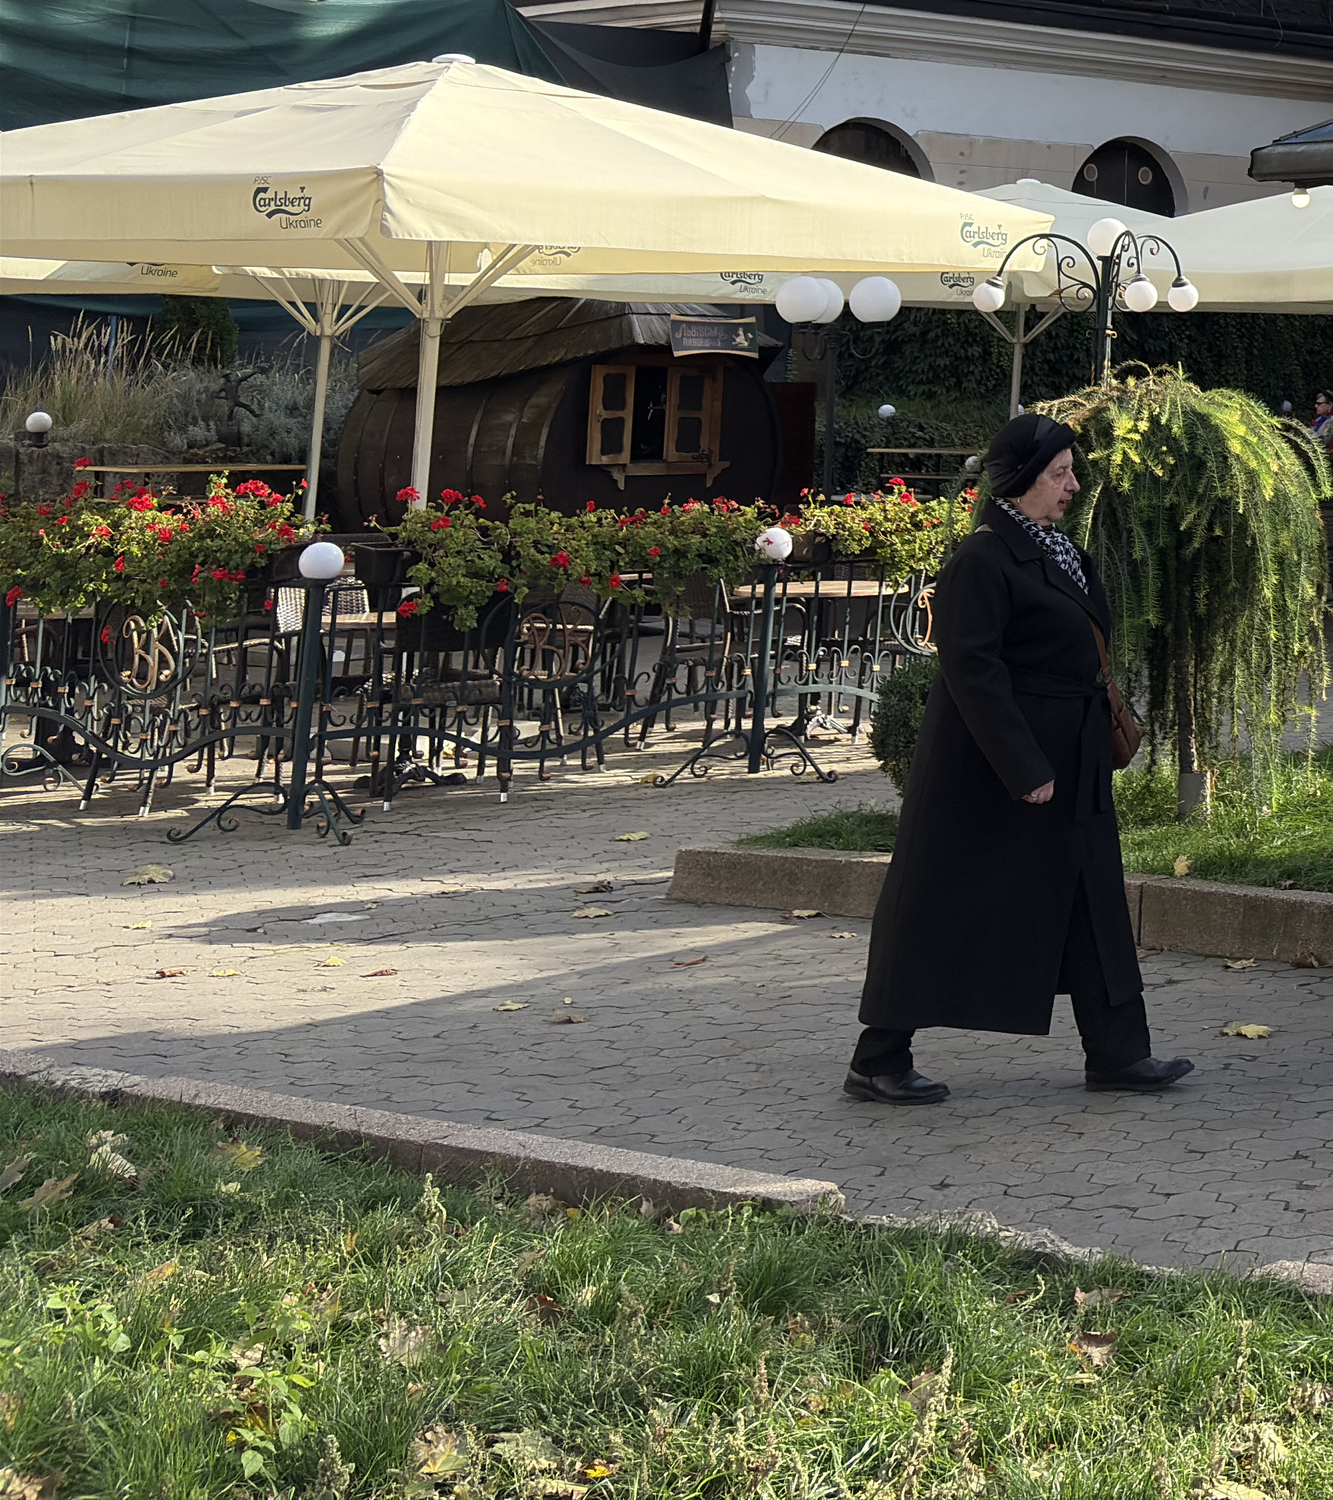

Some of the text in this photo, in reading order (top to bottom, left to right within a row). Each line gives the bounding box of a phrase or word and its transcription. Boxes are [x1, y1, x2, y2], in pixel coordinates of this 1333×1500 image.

[252, 186, 313, 219] Carlsberg
[279, 216, 323, 230] Ukraine
[960, 222, 1008, 249] Carlsberg
[140, 265, 178, 278] Ukraine
[940, 272, 975, 289] Carlsberg
[739, 284, 768, 295] Ukraine
